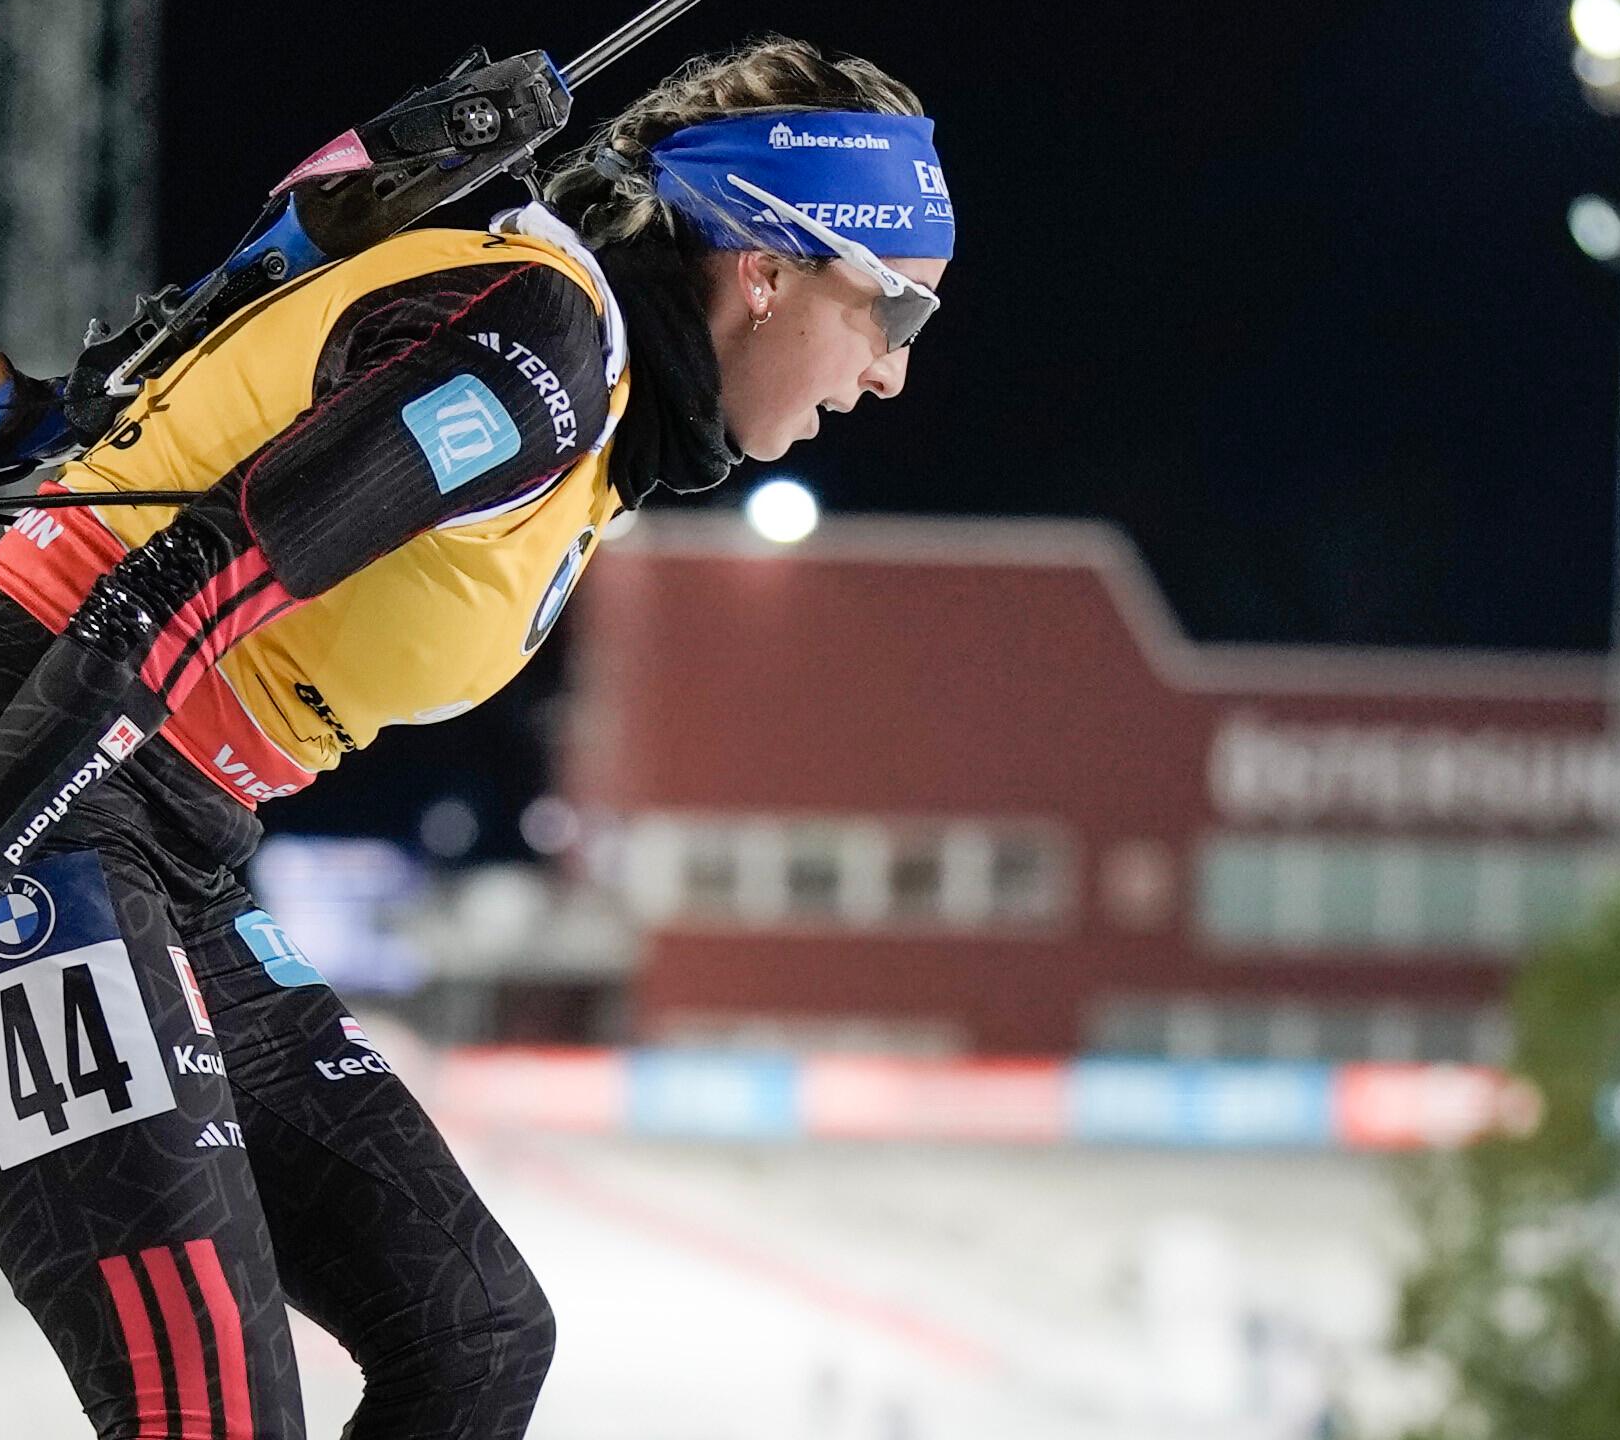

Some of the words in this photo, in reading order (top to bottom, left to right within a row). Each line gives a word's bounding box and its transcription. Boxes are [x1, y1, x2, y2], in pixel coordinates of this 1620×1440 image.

[795, 202, 914, 230] TERREX
[504, 341, 578, 455] TERREX
[3, 752, 112, 866] Kaufland
[0, 962, 133, 1136] 44
